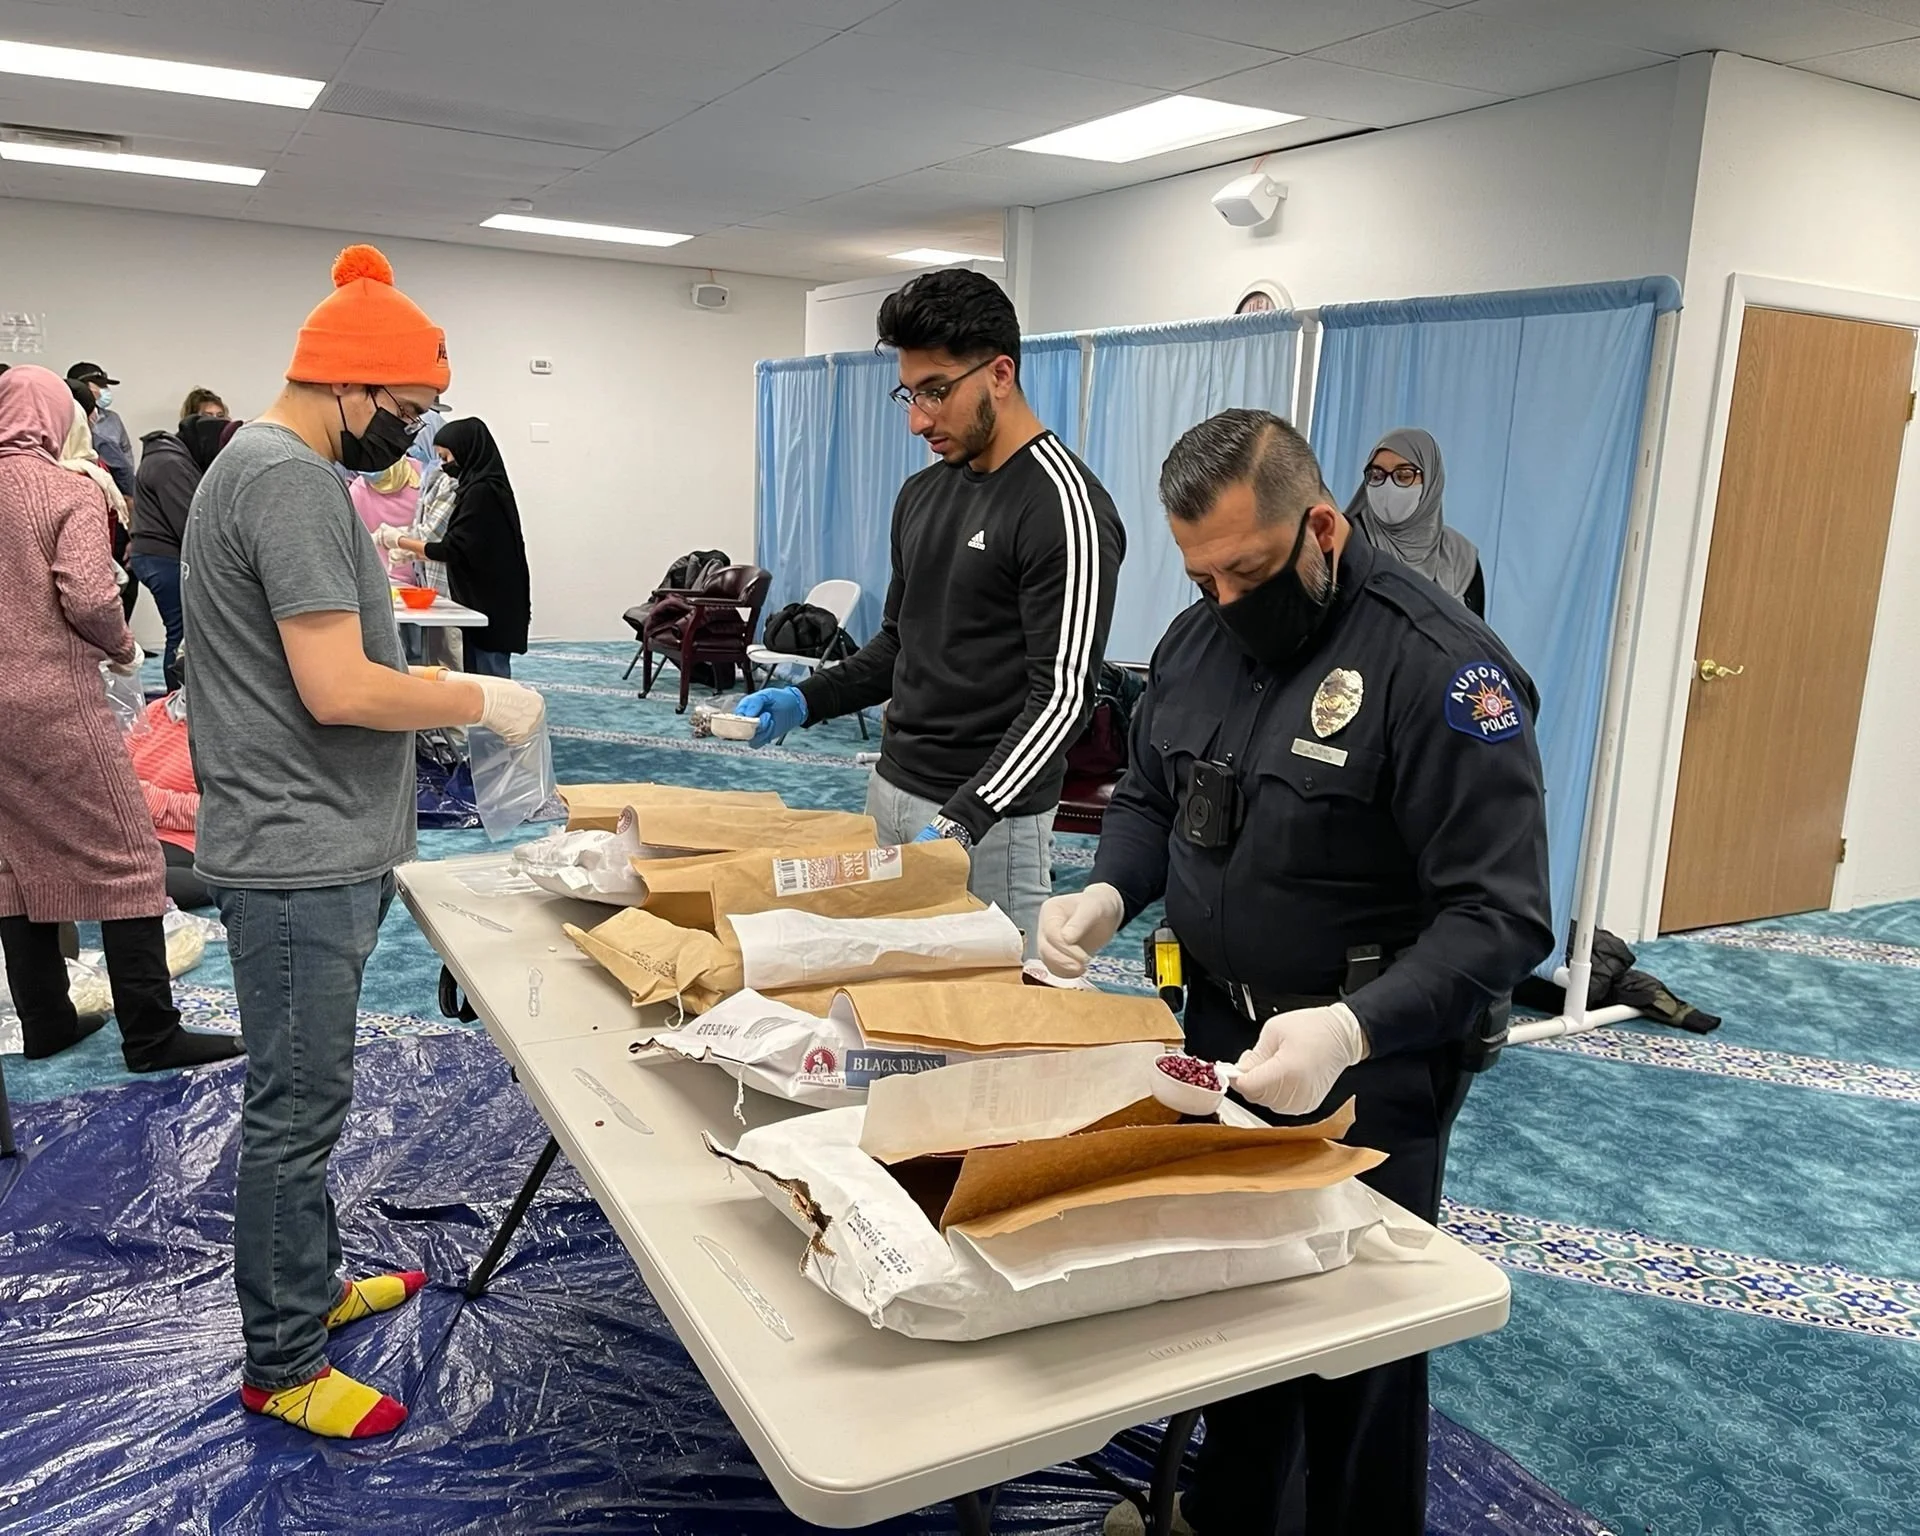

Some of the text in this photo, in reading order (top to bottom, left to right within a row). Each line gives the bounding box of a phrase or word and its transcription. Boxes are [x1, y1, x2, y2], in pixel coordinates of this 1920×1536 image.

[1480, 712, 1519, 735] POLICE
[853, 1057, 940, 1073] BLACK BEANS
